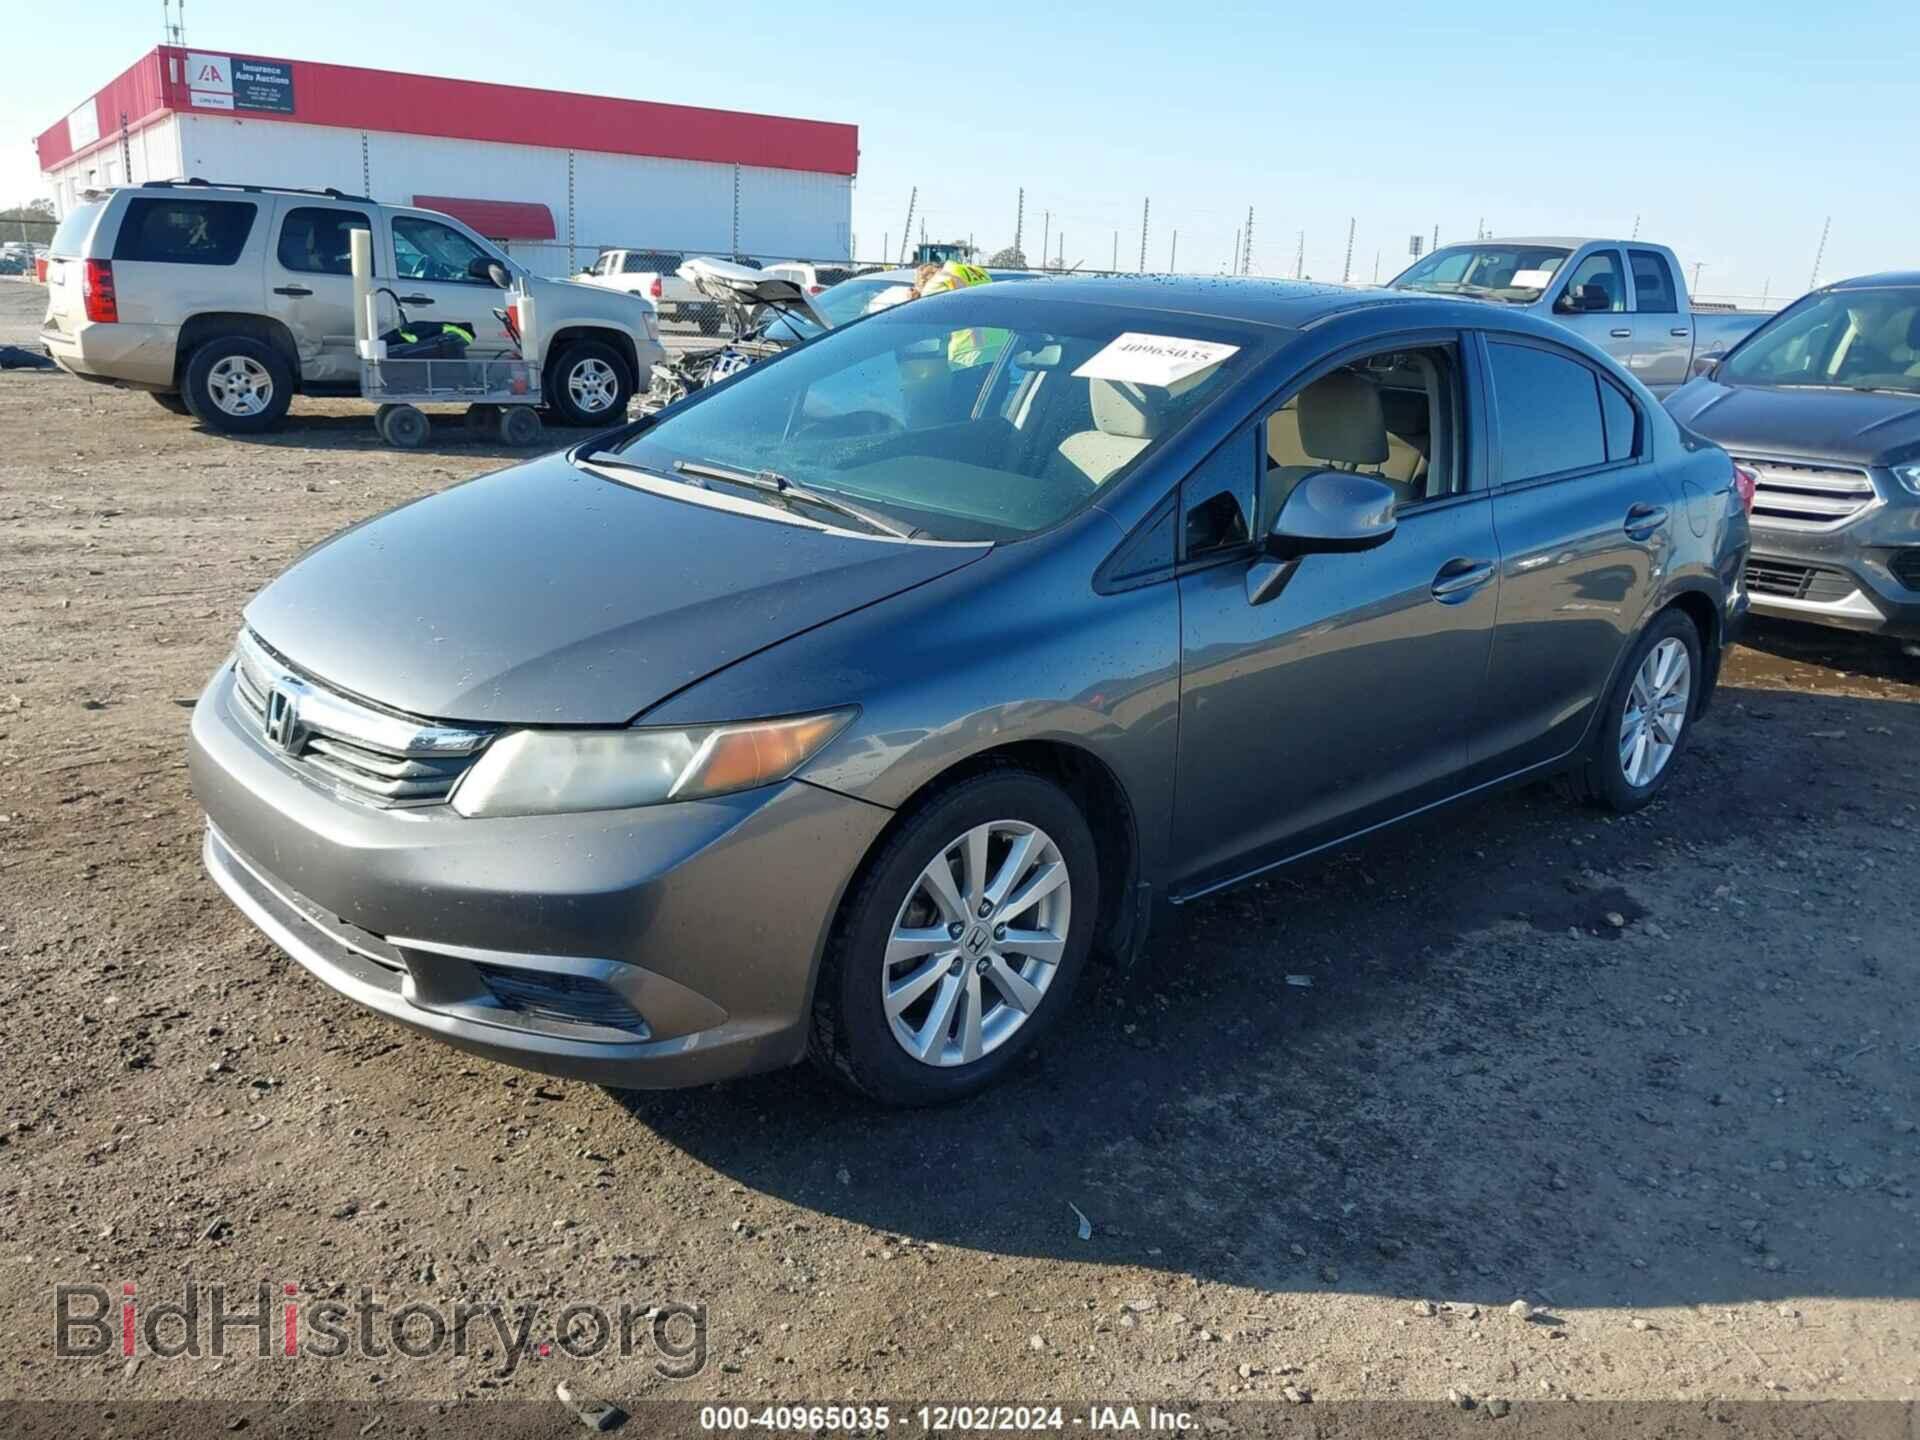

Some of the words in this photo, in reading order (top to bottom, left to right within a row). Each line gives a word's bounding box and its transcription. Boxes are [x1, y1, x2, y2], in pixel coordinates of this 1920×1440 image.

[242, 63, 281, 74] Insurance
[235, 72, 254, 81] Auto
[255, 74, 290, 85] Auctions
